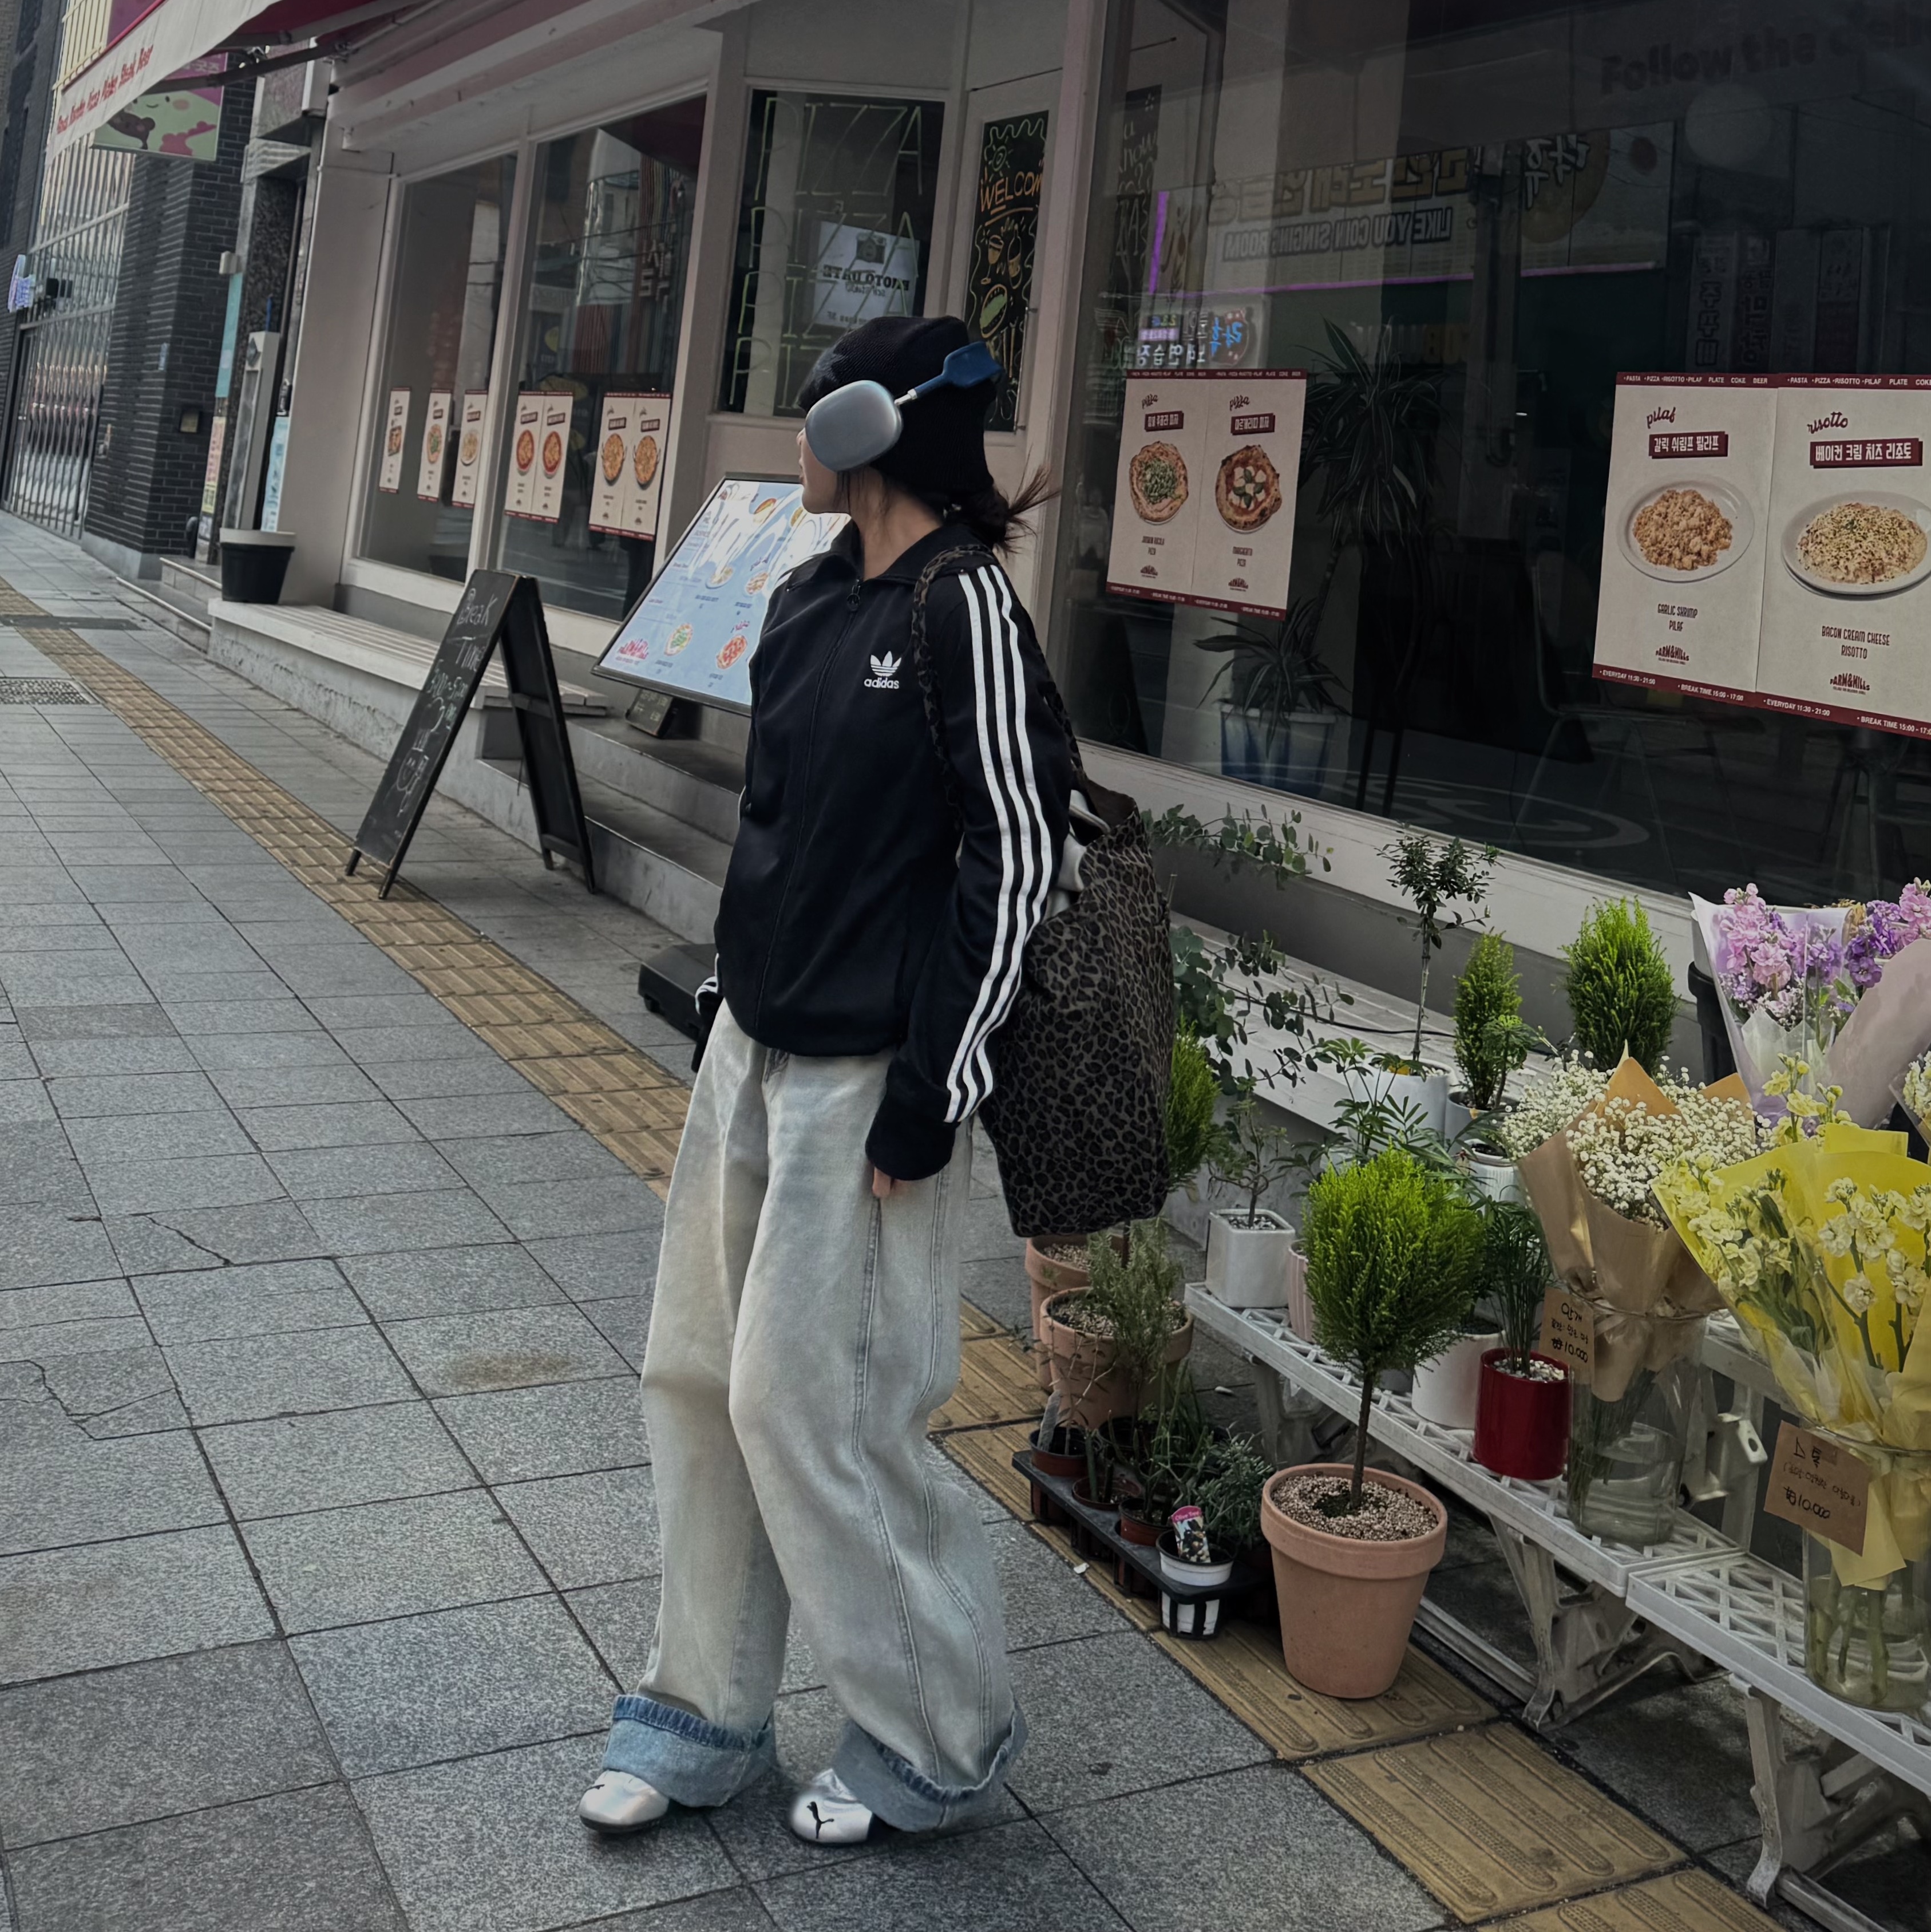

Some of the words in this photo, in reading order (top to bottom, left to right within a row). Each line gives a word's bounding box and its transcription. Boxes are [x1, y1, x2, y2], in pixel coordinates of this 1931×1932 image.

[755, 97, 923, 200] PIZZA
[1230, 394, 1250, 411] pizza
[1646, 406, 1676, 429] pilaf
[1807, 412, 1849, 434] risotto
[1653, 437, 1669, 453] 갈릭
[1671, 436, 1694, 452] 쉬림프
[1696, 435, 1719, 451] 필라프
[1815, 444, 1843, 461] 베이컨
[1846, 444, 1862, 461] 크림
[1866, 443, 1883, 460] 치즈
[1886, 442, 1912, 459] 리조토
[1657, 603, 1676, 617] GARLIC
[1669, 620, 1684, 632] PILAF
[1821, 625, 1842, 640] BACON
[1843, 628, 1865, 643] CREAM
[1867, 632, 1890, 646] CHEESE
[1841, 644, 1868, 659] RISOTTO
[1602, 669, 1627, 680] EVERYDAY
[864, 677, 900, 690] adidas
[1681, 683, 1699, 694] BREAK
[1699, 687, 1712, 696] TIME
[1766, 698, 1797, 711] EVERYDAY
[1797, 704, 1811, 713] 11:30
[1815, 708, 1830, 716] 21:00
[1861, 716, 1882, 727] BREAK
[1883, 719, 1898, 729] TIME
[1899, 723, 1915, 733] 15:00
[1561, 1302, 1582, 1322] 안개
